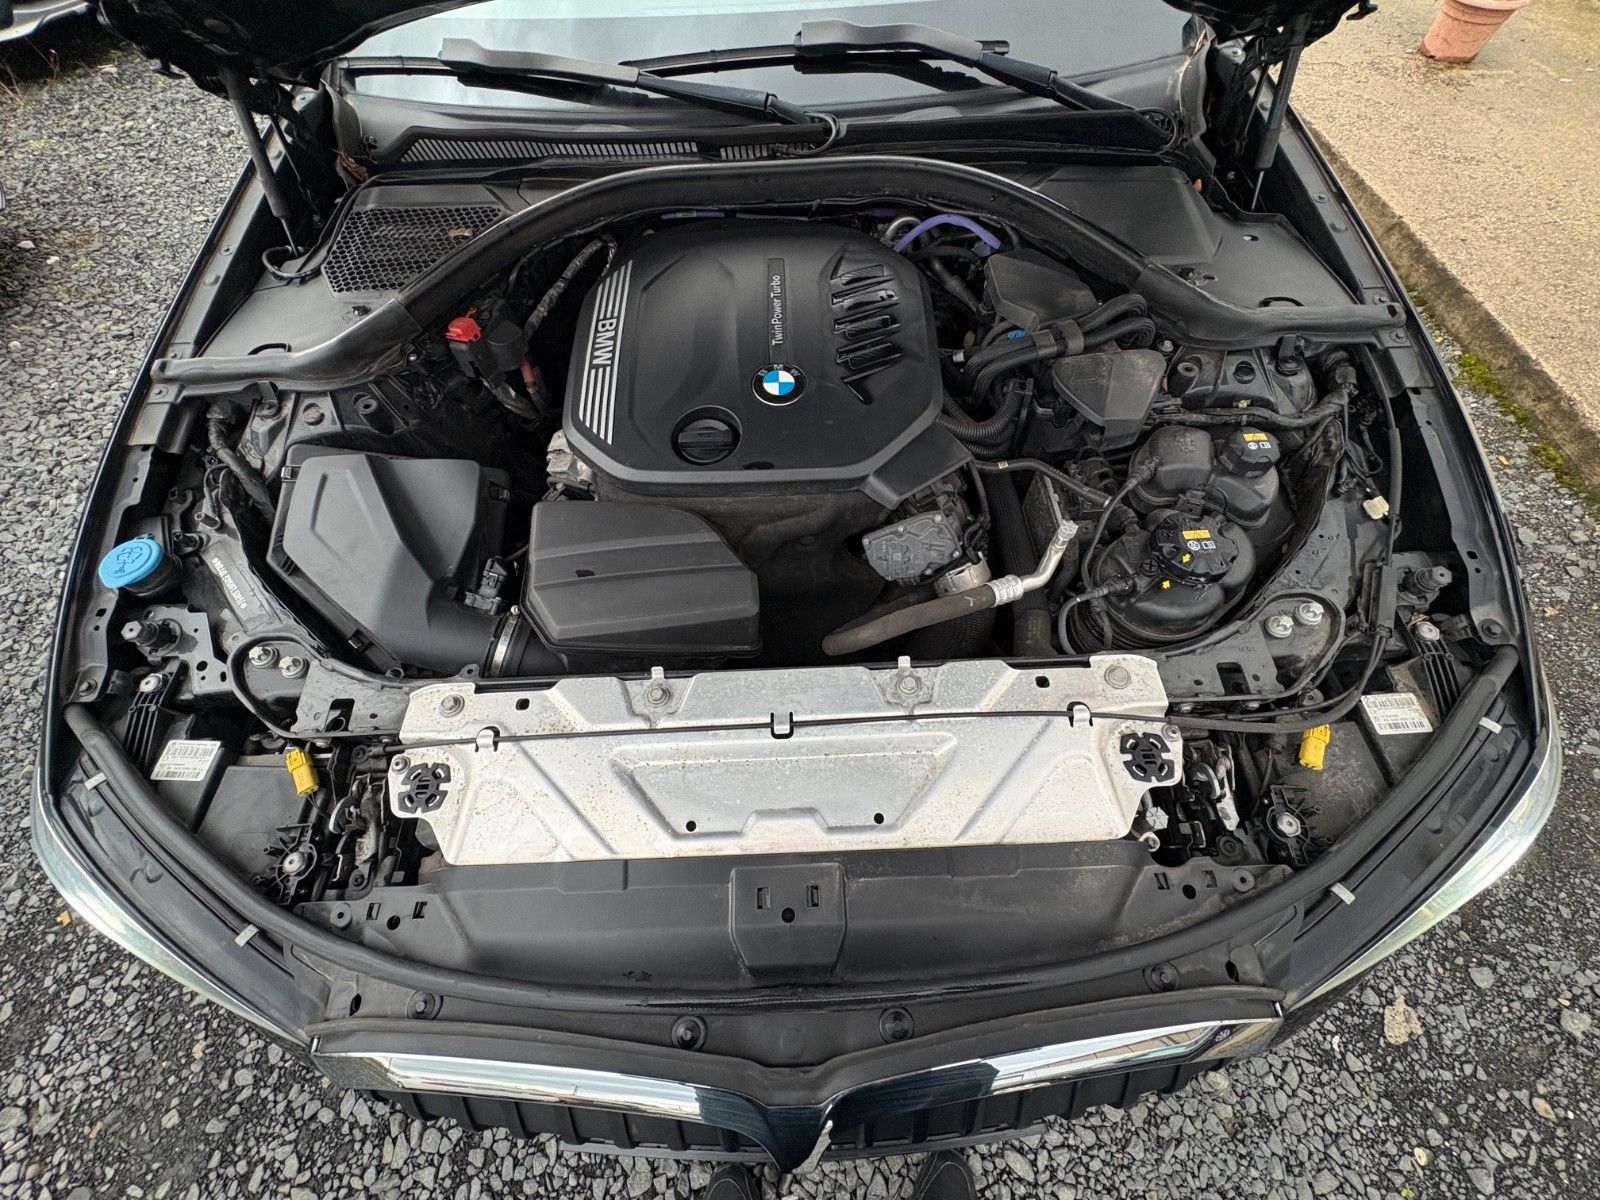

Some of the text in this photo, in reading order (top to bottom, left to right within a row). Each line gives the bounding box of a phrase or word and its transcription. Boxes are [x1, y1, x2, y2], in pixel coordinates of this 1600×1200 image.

[770, 275, 783, 346] TwinPower Turbo
[592, 318, 617, 365] BMW
[757, 364, 801, 377] BMW
